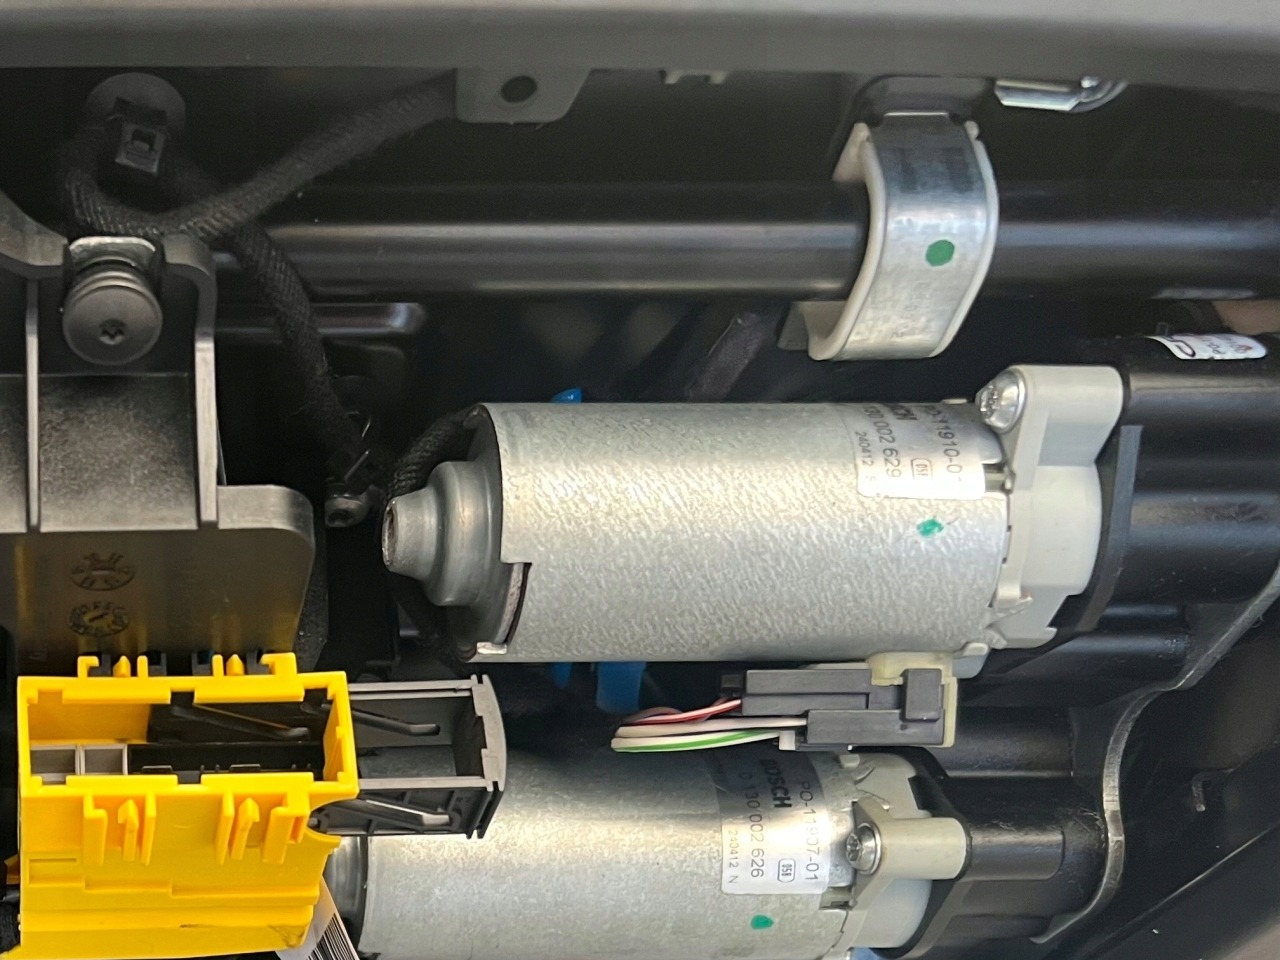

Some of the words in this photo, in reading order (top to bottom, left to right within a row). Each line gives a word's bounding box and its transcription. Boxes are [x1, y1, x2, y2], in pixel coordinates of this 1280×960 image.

[874, 421, 896, 443] 002
[855, 431, 873, 467] 240412
[882, 448, 902, 478] 629
[759, 759, 792, 808] BOSCH
[749, 814, 764, 842] 002
[751, 848, 764, 878] 626
[729, 875, 738, 884] N
